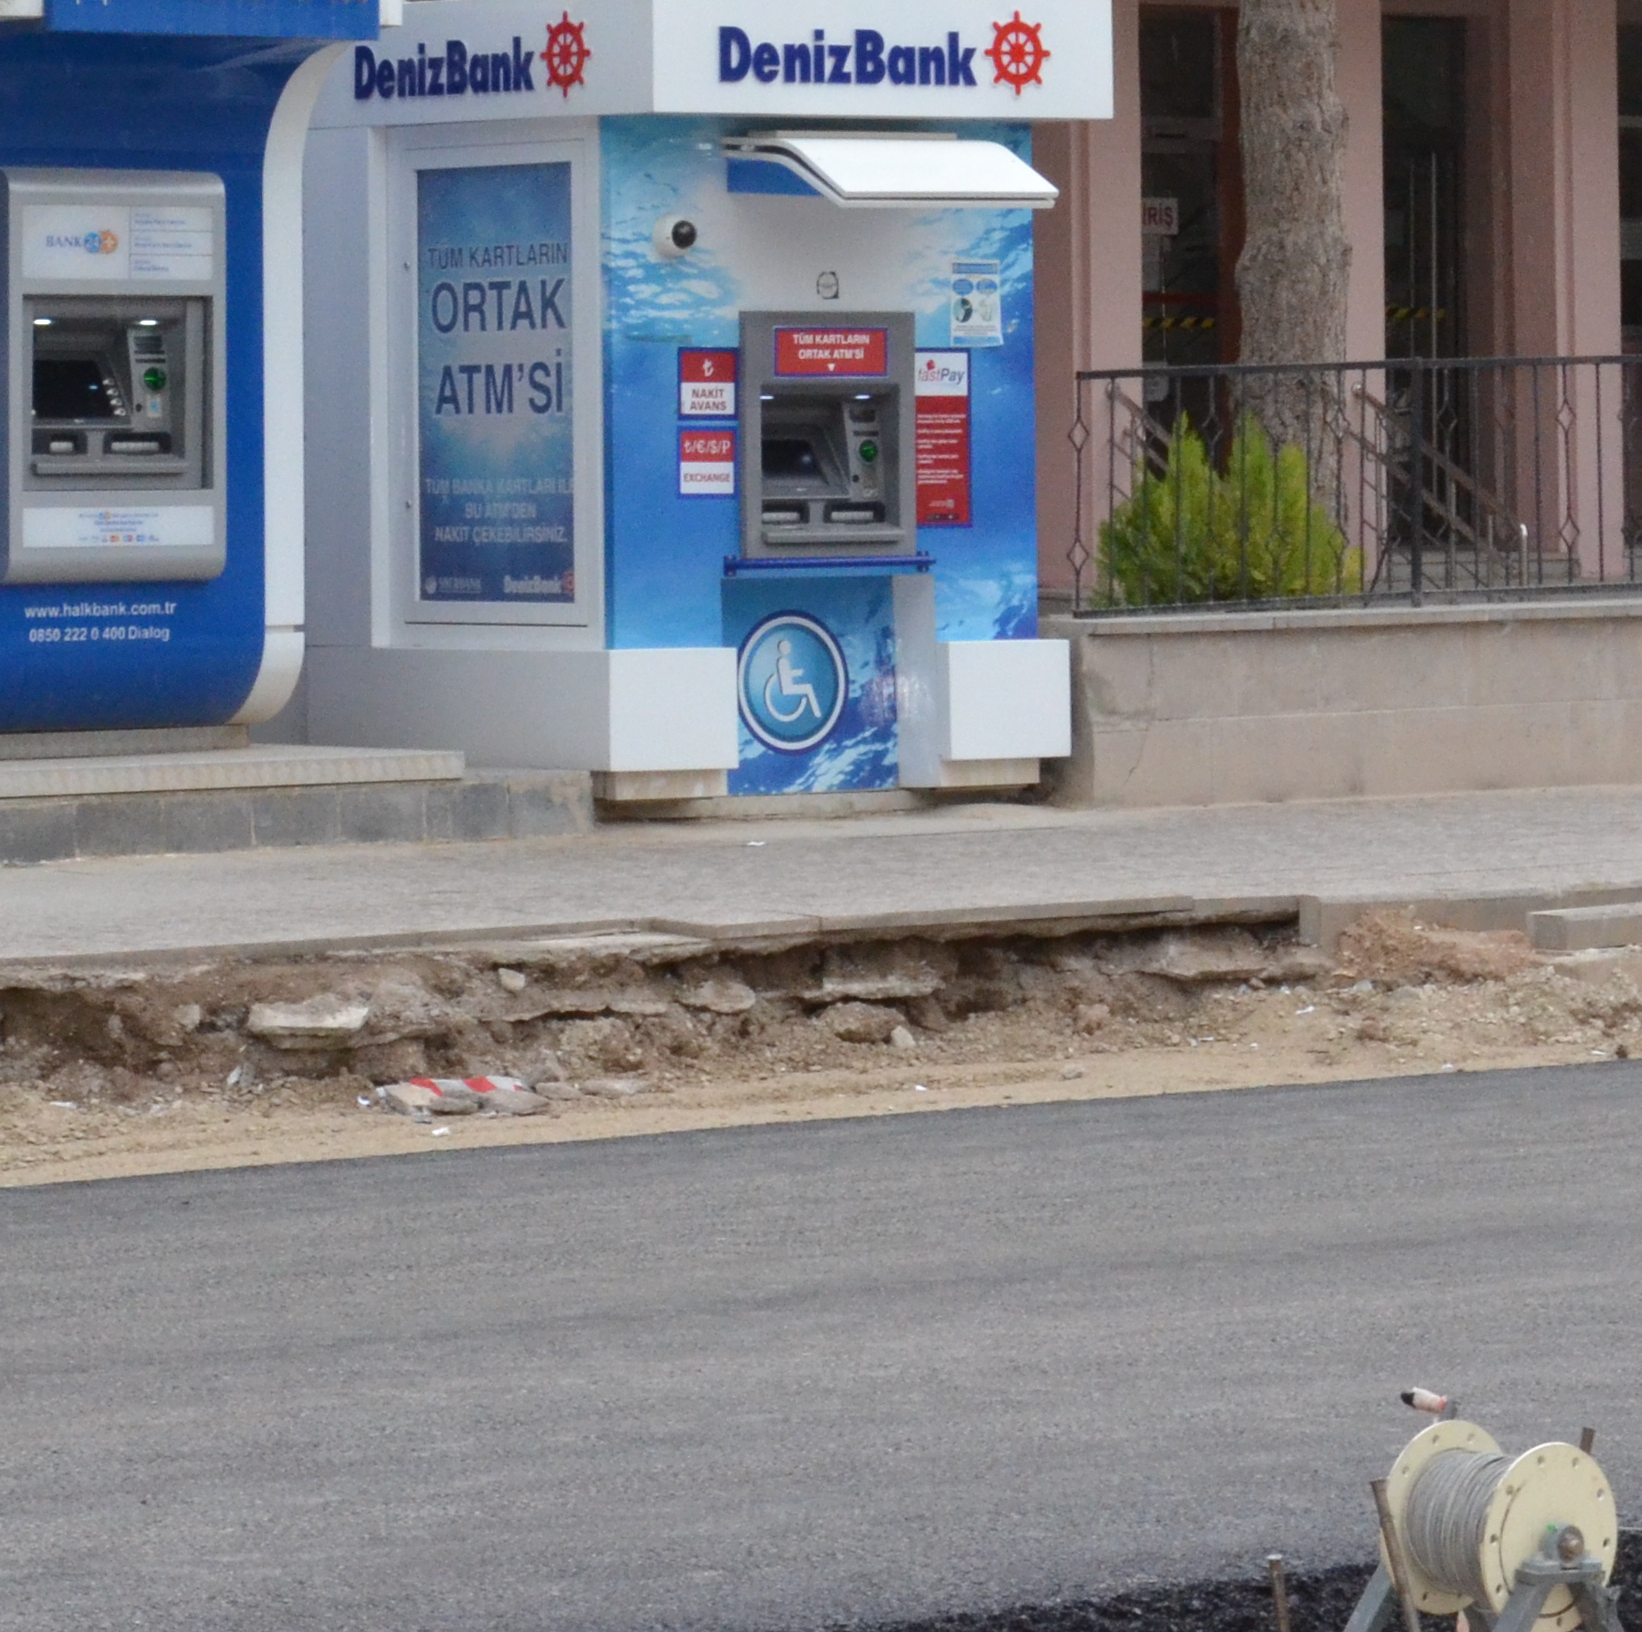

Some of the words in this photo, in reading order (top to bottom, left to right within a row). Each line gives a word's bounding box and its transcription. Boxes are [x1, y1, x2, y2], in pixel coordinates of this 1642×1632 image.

[718, 25, 978, 87] DenizBank
[354, 35, 536, 100] DenizBank
[45, 234, 83, 248] BANK
[469, 242, 569, 268] KARTLARIN
[431, 277, 567, 334] ORTAK
[793, 332, 814, 345] TÜM
[815, 333, 871, 345] KARTLARIN
[798, 349, 832, 360] ORTAK
[434, 348, 564, 415] ATM'Sİ
[691, 387, 726, 399] NAKİT
[689, 400, 728, 412] AVANS
[452, 478, 494, 495] BANKA
[496, 478, 556, 495] KARTLARI
[683, 472, 731, 484] EXCHANGE
[503, 575, 562, 594] DenizBank
[24, 600, 177, 619] www.halkbank.com.tr
[28, 628, 61, 643] 0850
[63, 627, 88, 642] 222
[90, 627, 100, 641] 0
[102, 626, 126, 641] 400
[128, 625, 171, 643] Dialog
